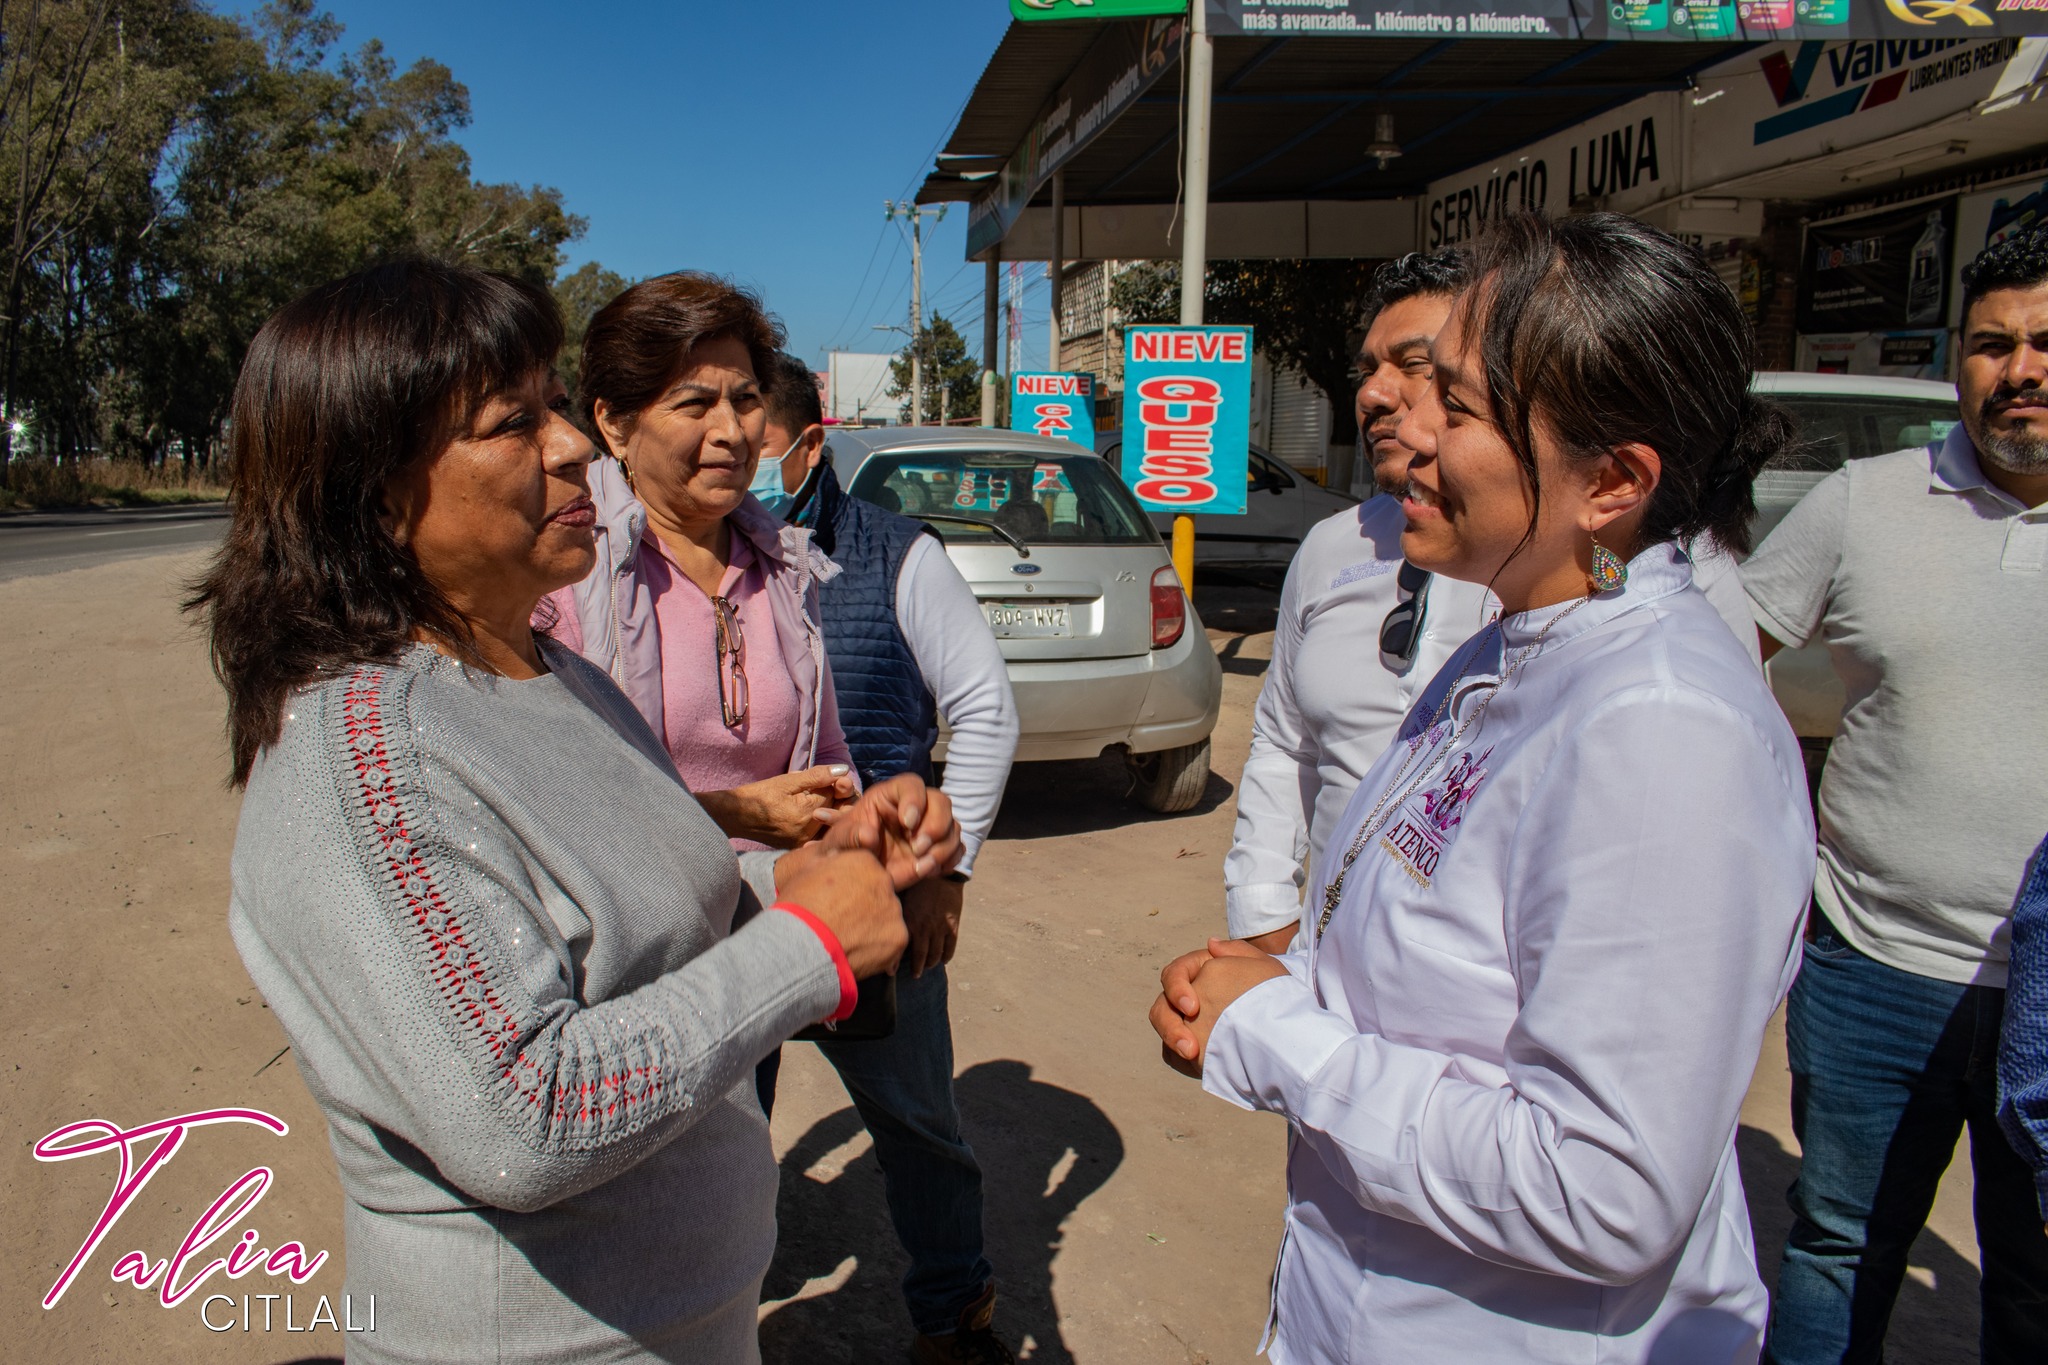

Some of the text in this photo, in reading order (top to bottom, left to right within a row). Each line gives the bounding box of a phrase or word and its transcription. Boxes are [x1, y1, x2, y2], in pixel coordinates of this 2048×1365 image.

[1242, 10, 1550, 33] más avanzada... kilómetro a kilómetro.
[1909, 38, 2019, 93] LUBRICANTES PREMIUM
[1429, 116, 1660, 250] SERVICIO LUNA
[1816, 239, 1864, 272] Mobil
[1132, 332, 1246, 362] NIEVE
[1017, 375, 1091, 396] NIEVE
[1135, 375, 1224, 506] QUESO
[1385, 818, 1441, 877] ATENCO
